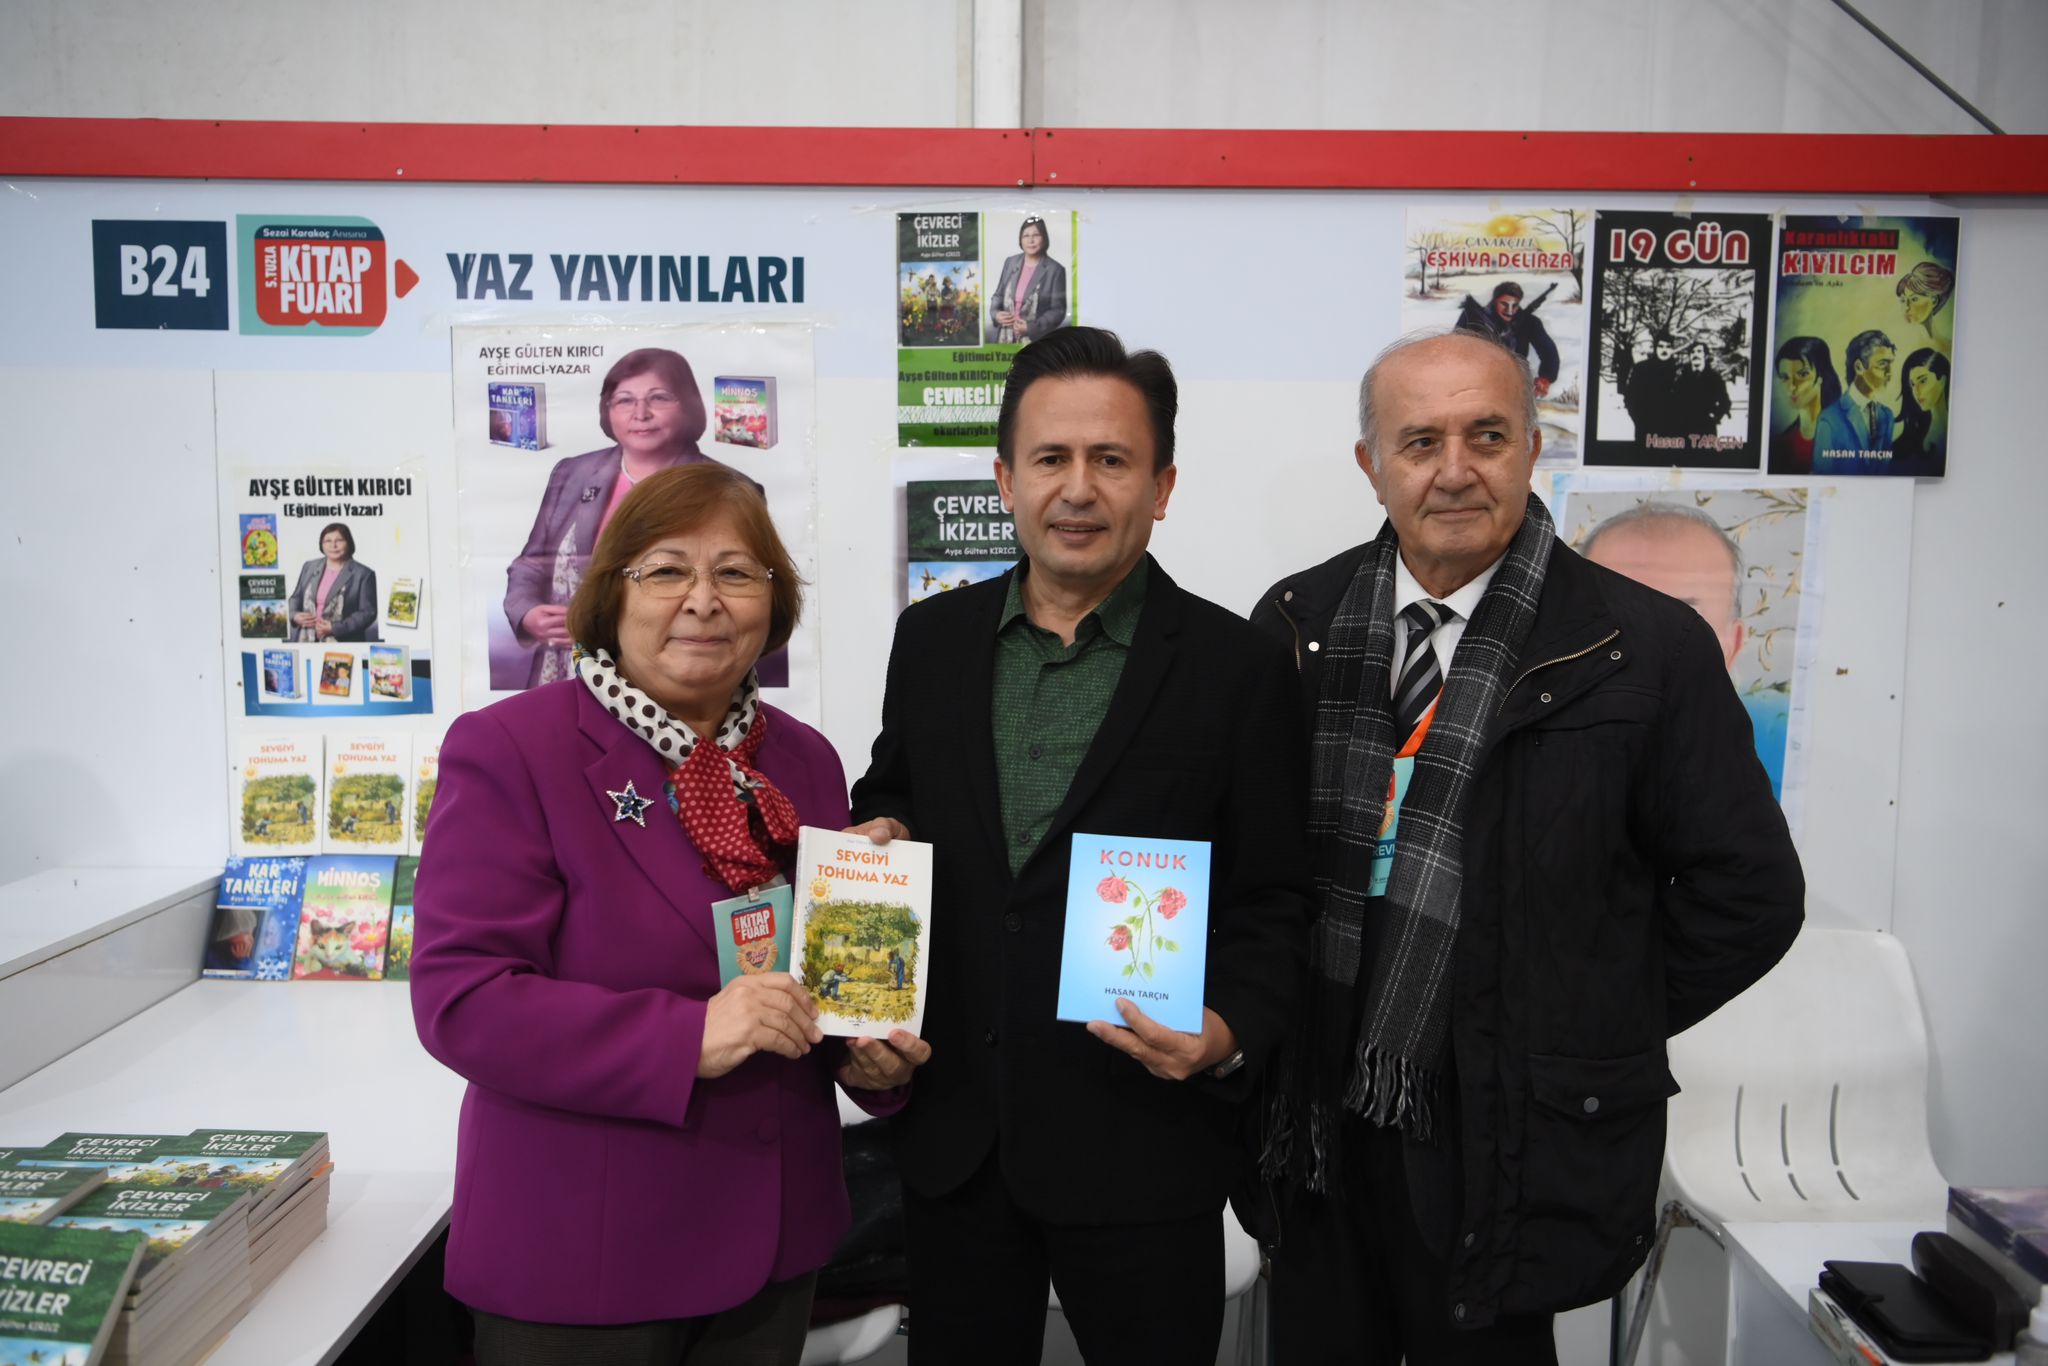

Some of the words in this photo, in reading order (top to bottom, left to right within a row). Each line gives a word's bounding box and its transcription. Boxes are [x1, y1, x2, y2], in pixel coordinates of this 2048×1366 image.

[914, 213, 962, 232] ÇEVRECİ
[263, 228, 290, 238] Sezai
[291, 229, 330, 239] Karakoç
[332, 230, 367, 239] Anısına
[917, 231, 960, 248] İKİZLER
[1610, 228, 1657, 264] 19
[1664, 221, 1750, 264] GÜN
[120, 244, 211, 297] B24
[280, 244, 372, 282] KİTAP
[1782, 250, 1897, 276] KIVILCIM
[446, 252, 534, 301] YAZ
[550, 254, 805, 304] YAYINLARI
[280, 282, 363, 315] FUARI
[479, 346, 511, 361] AYŞE
[515, 343, 563, 359] GÜLTEN
[567, 345, 604, 358] KIRICI
[953, 351, 994, 363] Eğitimci
[996, 351, 1017, 362] Yaz
[487, 362, 591, 376] EĞİTİMCİ-YAZAR
[899, 371, 923, 383] Ayşe
[925, 370, 957, 381] Gülten
[959, 369, 1008, 381] KIRICI'nı
[923, 384, 991, 407] ÇEVRECİ
[1645, 433, 1685, 448] Hasan
[1822, 449, 1856, 459] HASAN
[1858, 450, 1893, 460] TARÇIN
[249, 478, 290, 500] AYŞE
[294, 475, 354, 497] GÜLTEN
[358, 478, 412, 496] KIRICI
[283, 503, 342, 518] (Eğitimci
[344, 503, 383, 517] Yazar)
[933, 495, 1015, 519] ÇEVRE
[940, 518, 1015, 541] İKİZLER
[945, 548, 962, 556] Ayşe
[964, 547, 988, 555] Gülten
[990, 547, 1017, 555] KIRICI
[260, 743, 295, 753] SEVGİYİ
[350, 742, 385, 751] SEVGİYİ
[248, 756, 288, 765] TOHUMA
[291, 755, 307, 763] YAZ
[337, 754, 377, 762] TOHUMA
[836, 849, 889, 866] SEVGİYİ
[1100, 849, 1187, 871] KONUK
[248, 863, 280, 879] KAR
[317, 867, 381, 892] MİNNOŞ
[817, 864, 879, 883] TOHUMA
[883, 872, 910, 886] YAZ
[225, 876, 298, 896] TANELERİ
[740, 909, 770, 929] KİTAP
[742, 924, 770, 941] FUARI
[1104, 986, 1135, 998] HASAN
[1138, 989, 1169, 1001] TARÇIN
[76, 1138, 161, 1150] ÇEVRECİ
[202, 1141, 277, 1152] İKİZLER
[209, 1134, 293, 1147] ÇEVRECİ
[66, 1146, 142, 1157] İKİZLER
[117, 1190, 212, 1203] ÇEVRECİ
[107, 1200, 191, 1213] İKİZLER
[0, 1284, 70, 1316] İZLER
